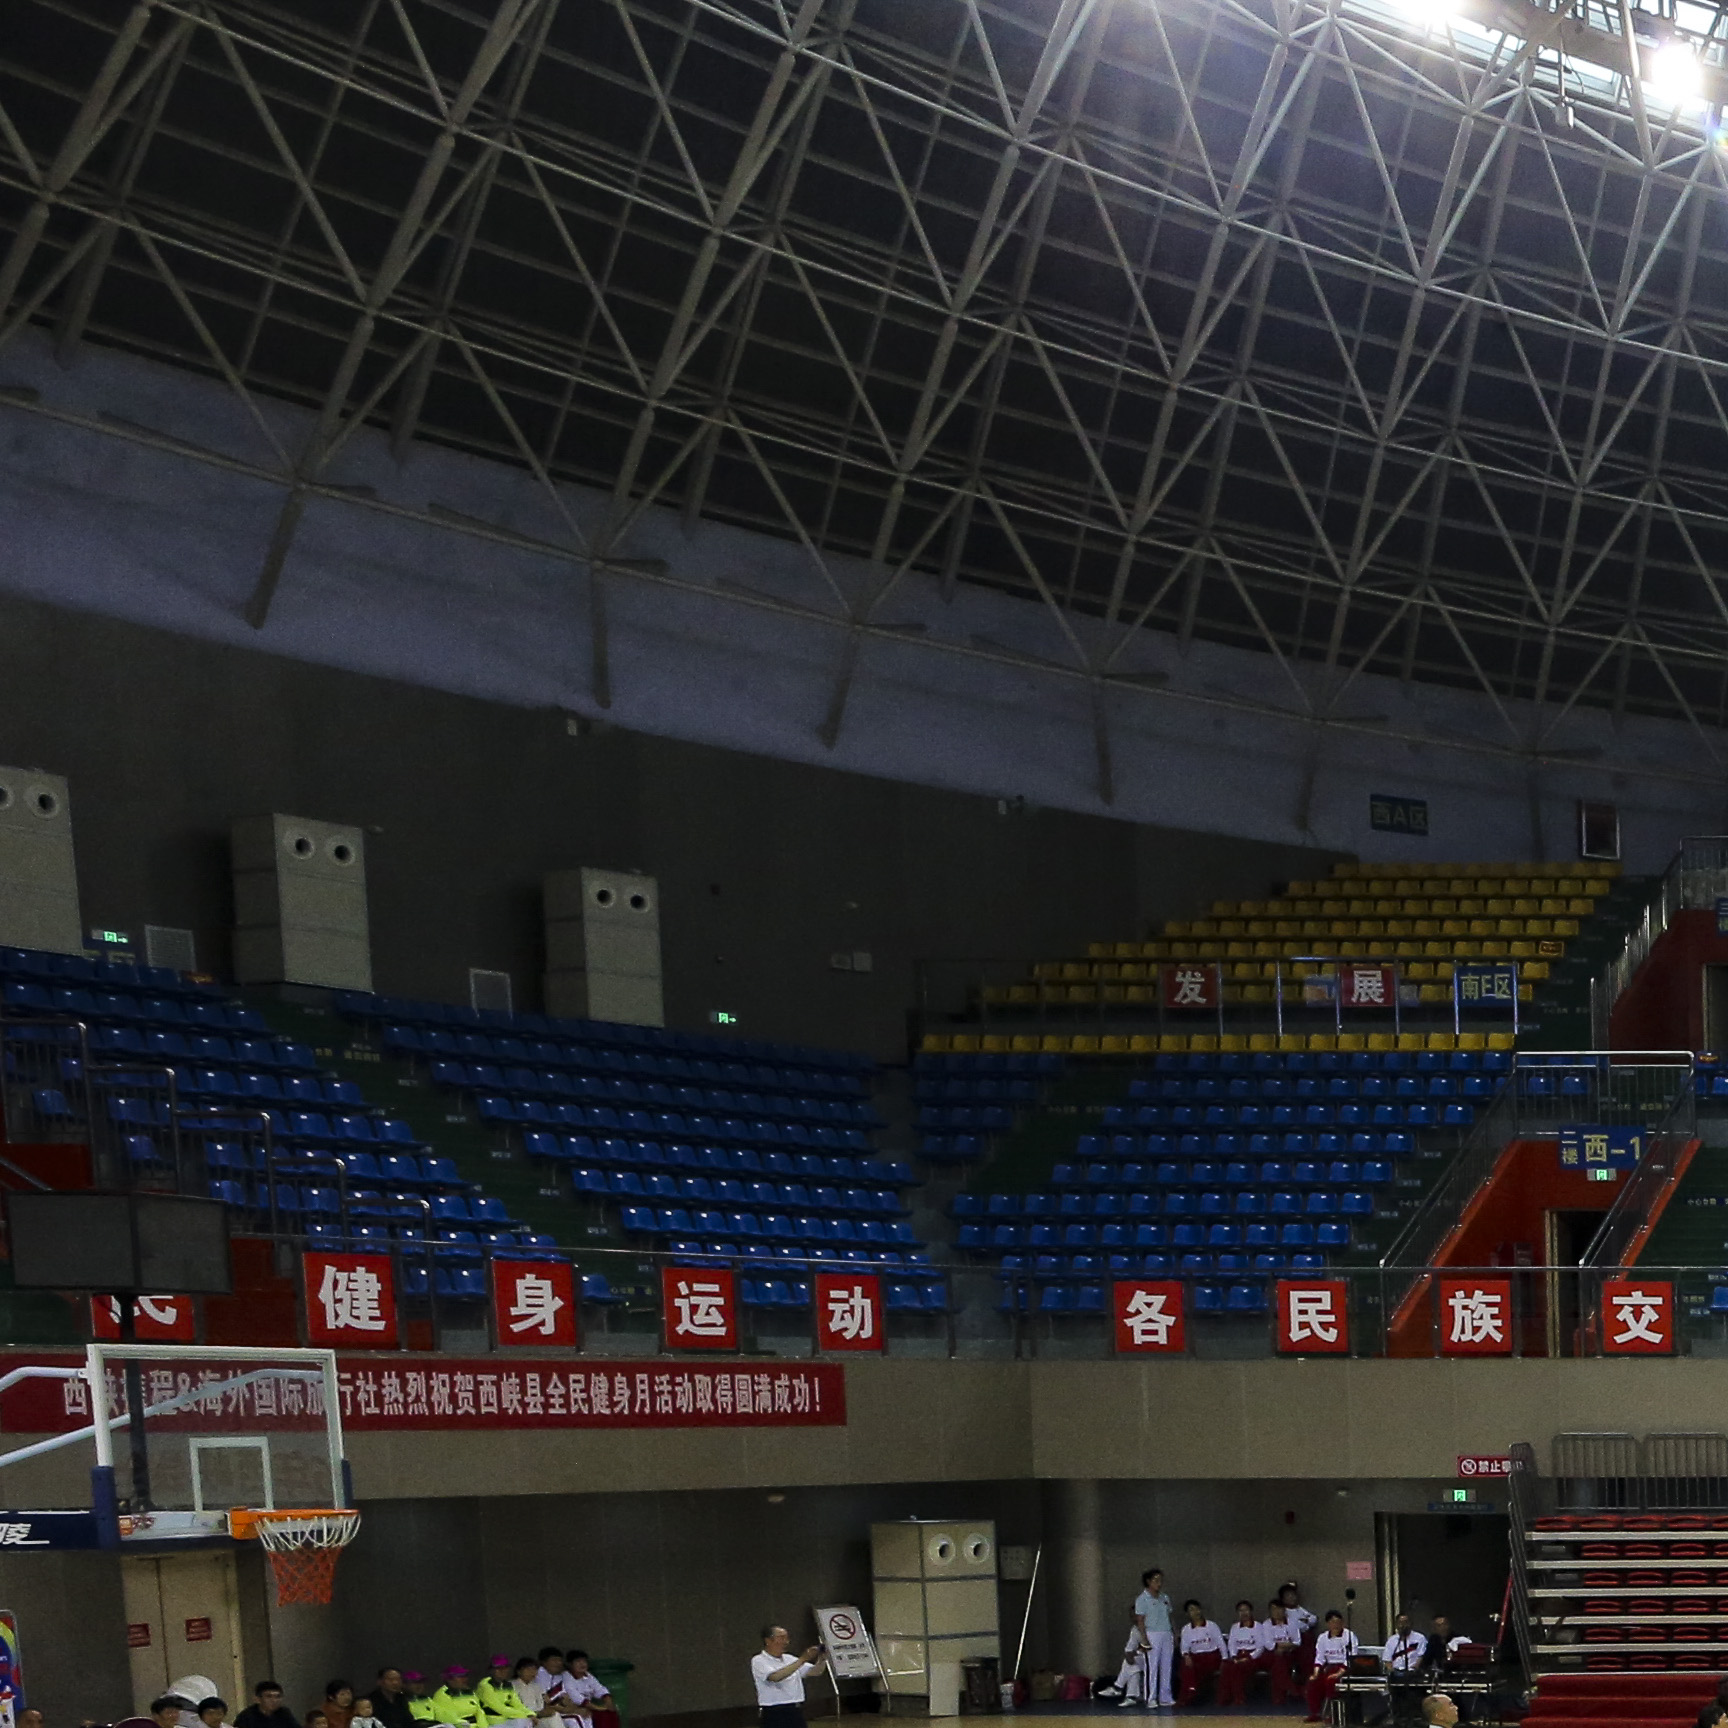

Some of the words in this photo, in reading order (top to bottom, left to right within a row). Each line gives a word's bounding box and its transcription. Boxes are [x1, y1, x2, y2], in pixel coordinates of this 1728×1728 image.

[1174, 971, 1206, 1004] 发
[1352, 970, 1385, 1003] 展
[319, 1265, 385, 1332] 健
[510, 1274, 564, 1335] 身
[674, 1281, 727, 1336] 运
[828, 1285, 873, 1340] 动
[1124, 1291, 1176, 1344] 各
[1288, 1291, 1338, 1342] 民
[1449, 1289, 1503, 1343] 族
[1612, 1290, 1664, 1343] 交
